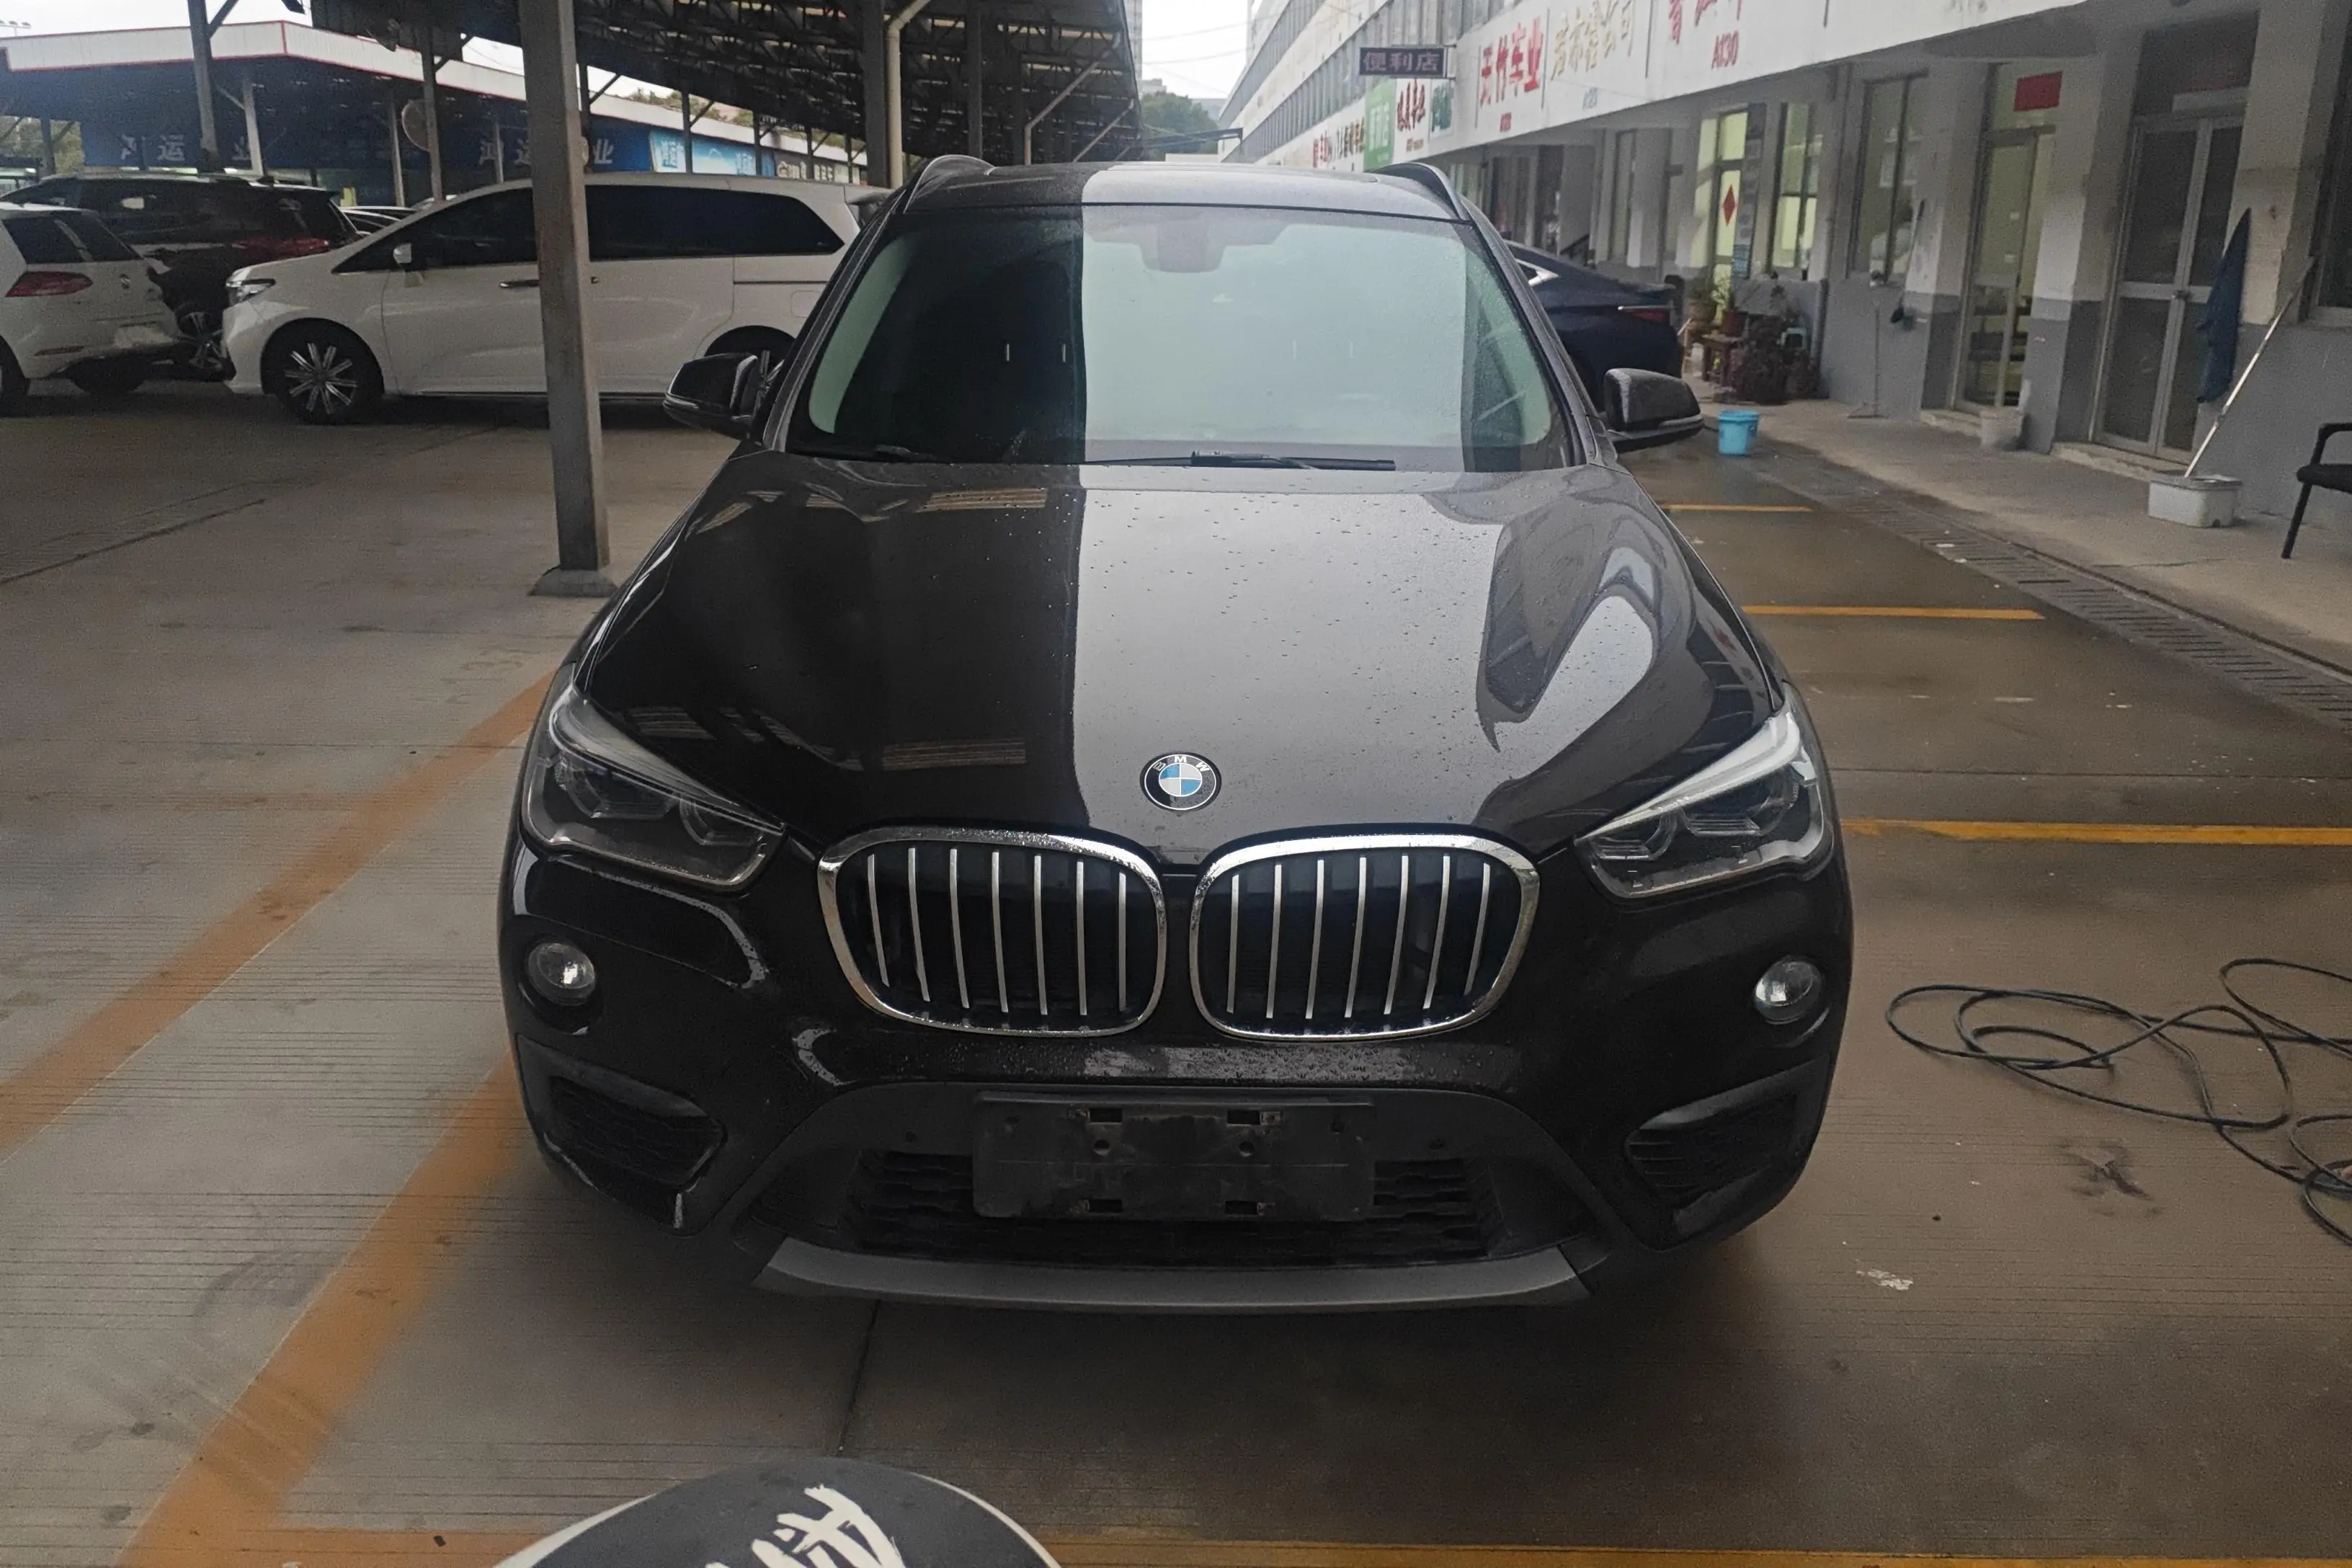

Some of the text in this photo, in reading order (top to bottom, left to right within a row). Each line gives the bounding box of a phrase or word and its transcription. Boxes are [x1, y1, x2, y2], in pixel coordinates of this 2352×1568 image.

[1363, 51, 1440, 71] 便利店
[1153, 756, 1210, 772] BMW
